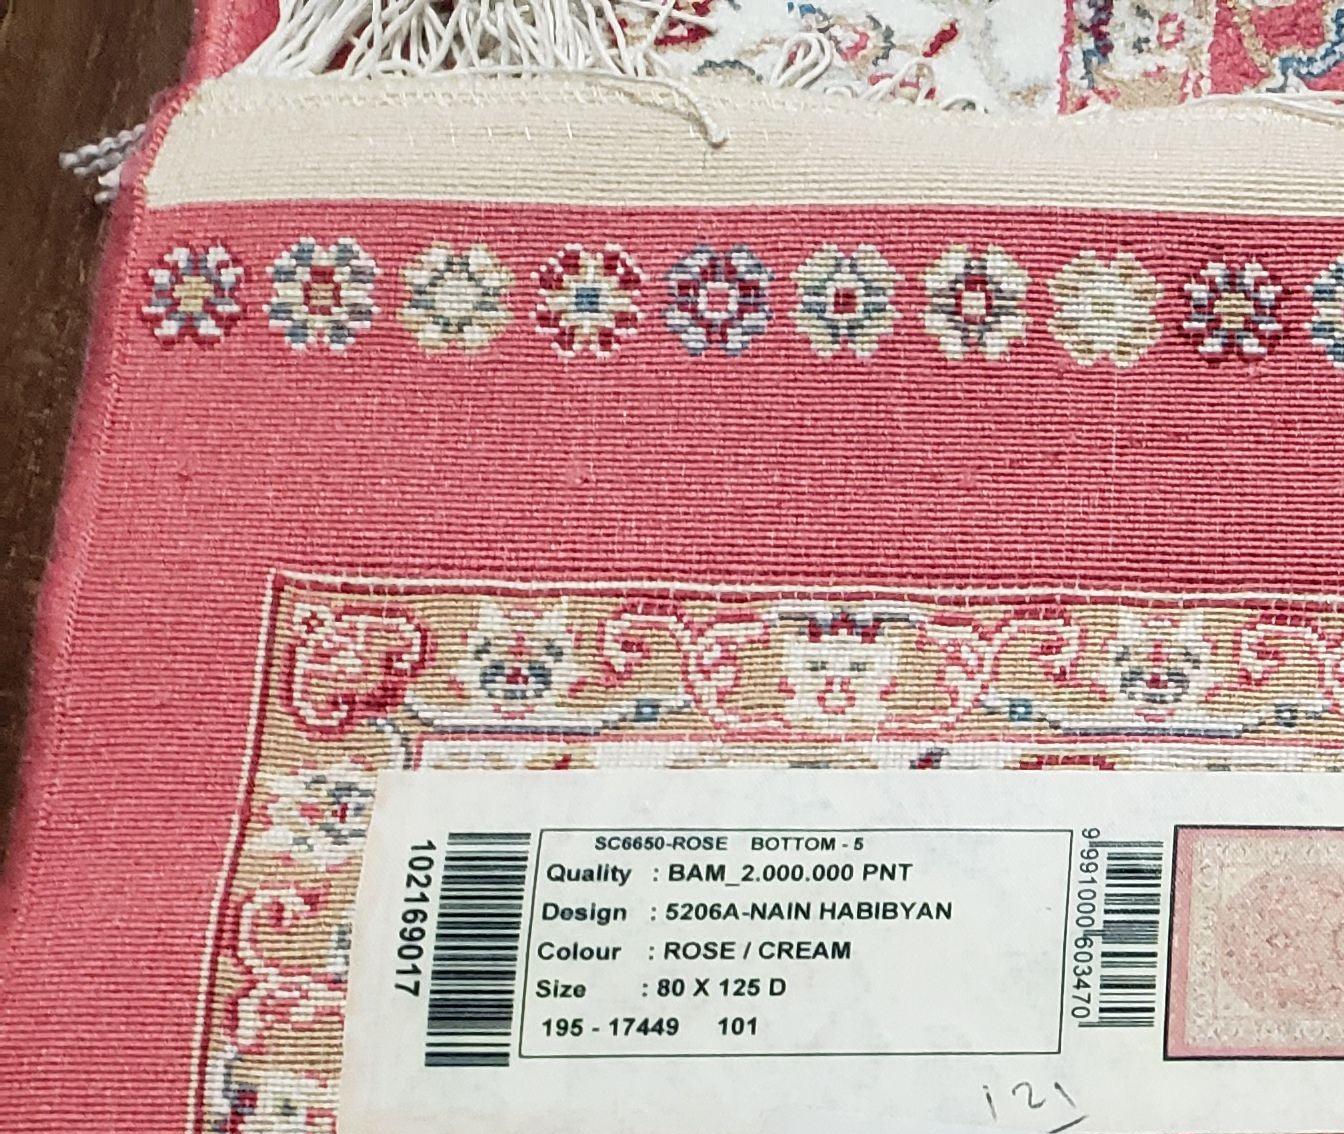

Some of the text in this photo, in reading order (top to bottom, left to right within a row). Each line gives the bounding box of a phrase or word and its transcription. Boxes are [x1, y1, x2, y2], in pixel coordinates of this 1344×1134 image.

[594, 836, 729, 852] SC6650-ROSE
[750, 836, 836, 852] BOTTOM
[853, 836, 865, 852] 5
[546, 862, 632, 887] Quality
[668, 862, 855, 887] BAM_2.000.000
[862, 862, 914, 882] PNT
[394, 839, 437, 998] 102169017
[541, 901, 628, 926] Design
[665, 901, 812, 921] 5206A-NAIN
[819, 901, 953, 921] HABIBYAN
[536, 940, 622, 961] Colour
[663, 940, 737, 961] ROSE
[743, 940, 752, 961] /
[758, 940, 852, 961] CREAM
[535, 978, 587, 999] Size
[656, 978, 685, 997] 80
[693, 978, 710, 997] X
[719, 978, 761, 997] 125
[769, 978, 787, 997] D
[541, 1017, 584, 1037] 195
[608, 1016, 680, 1037] 17449
[718, 1016, 758, 1036] 101
